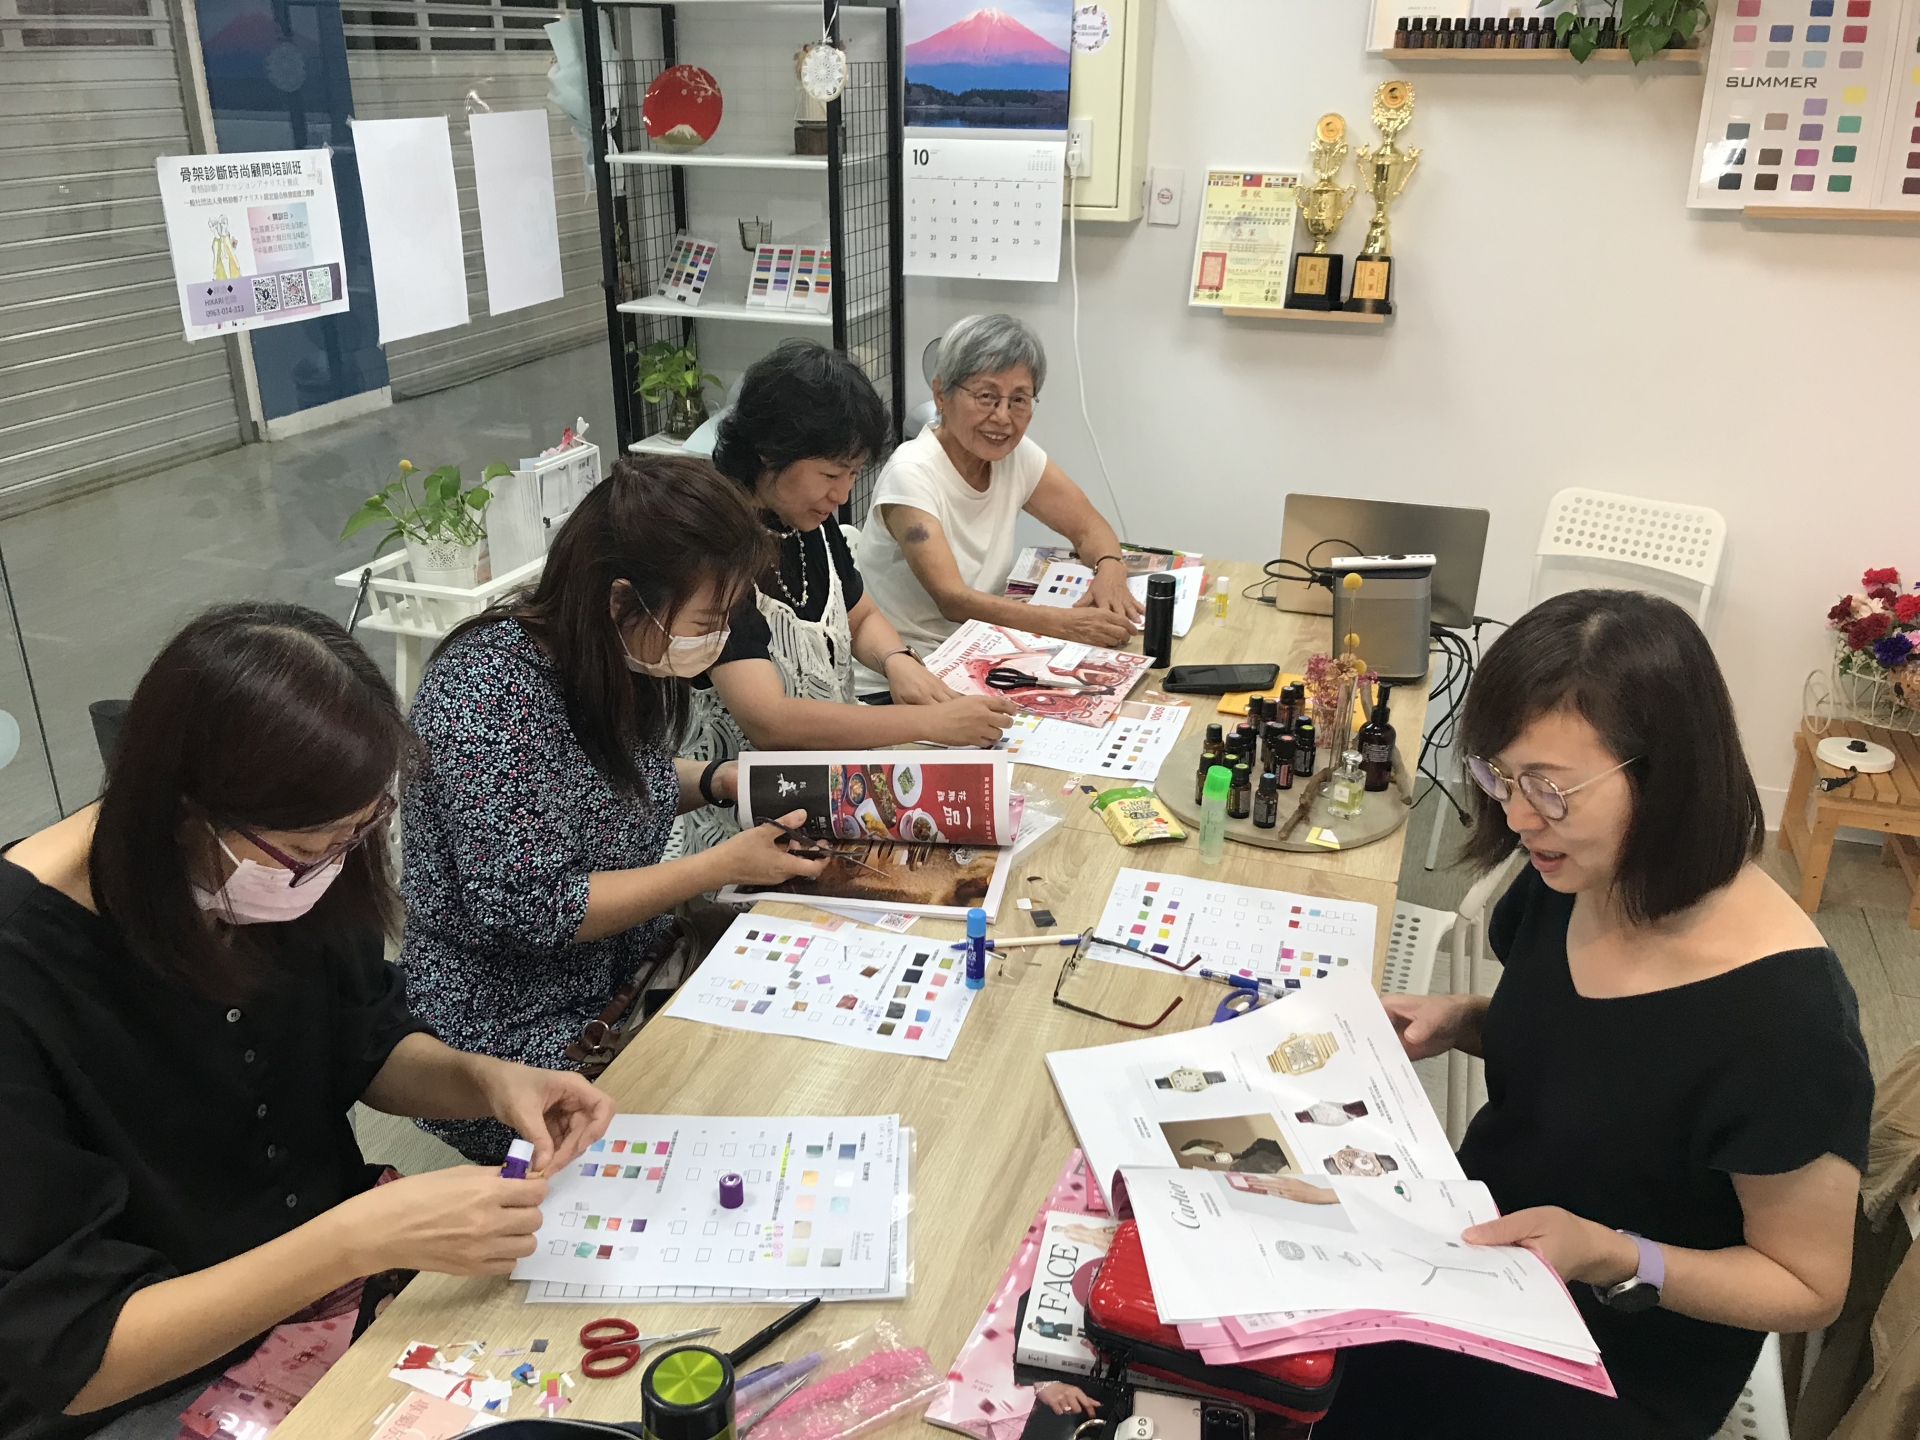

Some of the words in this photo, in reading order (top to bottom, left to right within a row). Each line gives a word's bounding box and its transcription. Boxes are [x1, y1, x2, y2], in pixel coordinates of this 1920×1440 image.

[1726, 77, 1818, 88] SUMMER
[912, 149, 929, 166] 10
[180, 161, 302, 182] 骨架診斷時尚顧問培訓班
[1168, 1180, 1201, 1229] Cartier
[1038, 1243, 1079, 1315] FACE
